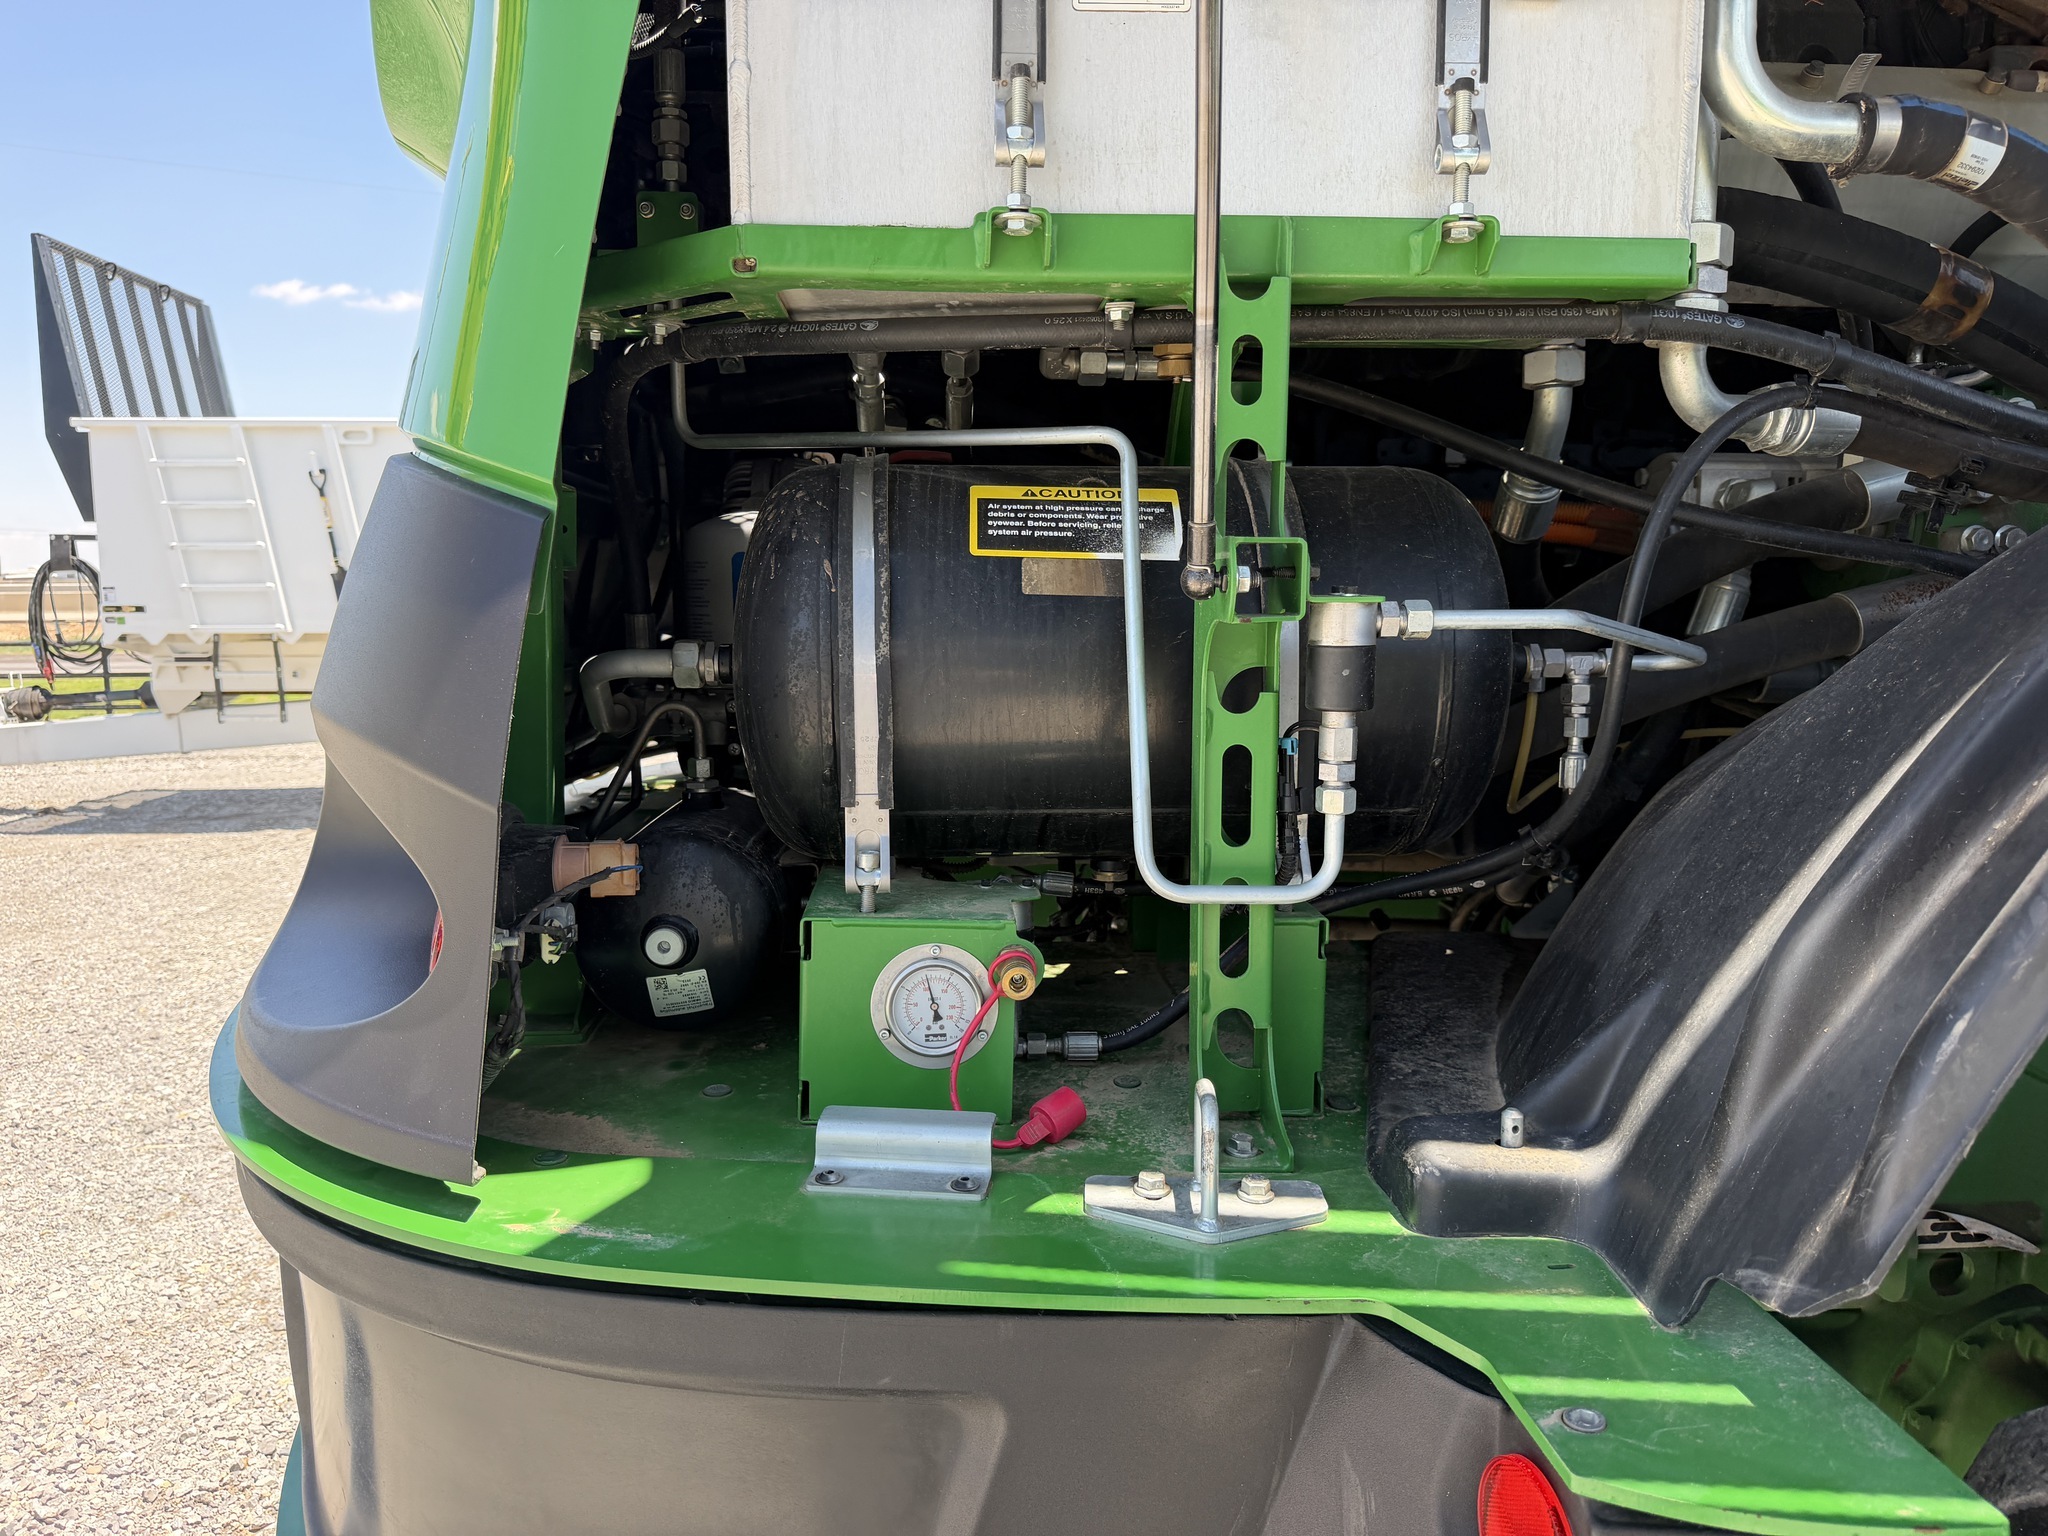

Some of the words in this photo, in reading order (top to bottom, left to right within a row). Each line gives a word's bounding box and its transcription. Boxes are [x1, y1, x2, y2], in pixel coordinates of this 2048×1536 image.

[1388, 308, 1412, 317] Type
[1414, 309, 1438, 317] 4079
[1442, 308, 1460, 317] ISO
[1463, 308, 1485, 317] mm)
[1488, 308, 1512, 317] (15.9
[1537, 308, 1558, 317] PSI)
[1561, 308, 1583, 317] (350
[1585, 308, 1609, 316] MPa
[1652, 308, 1680, 318] 10GT
[1039, 488, 1121, 498] CAUTIO
